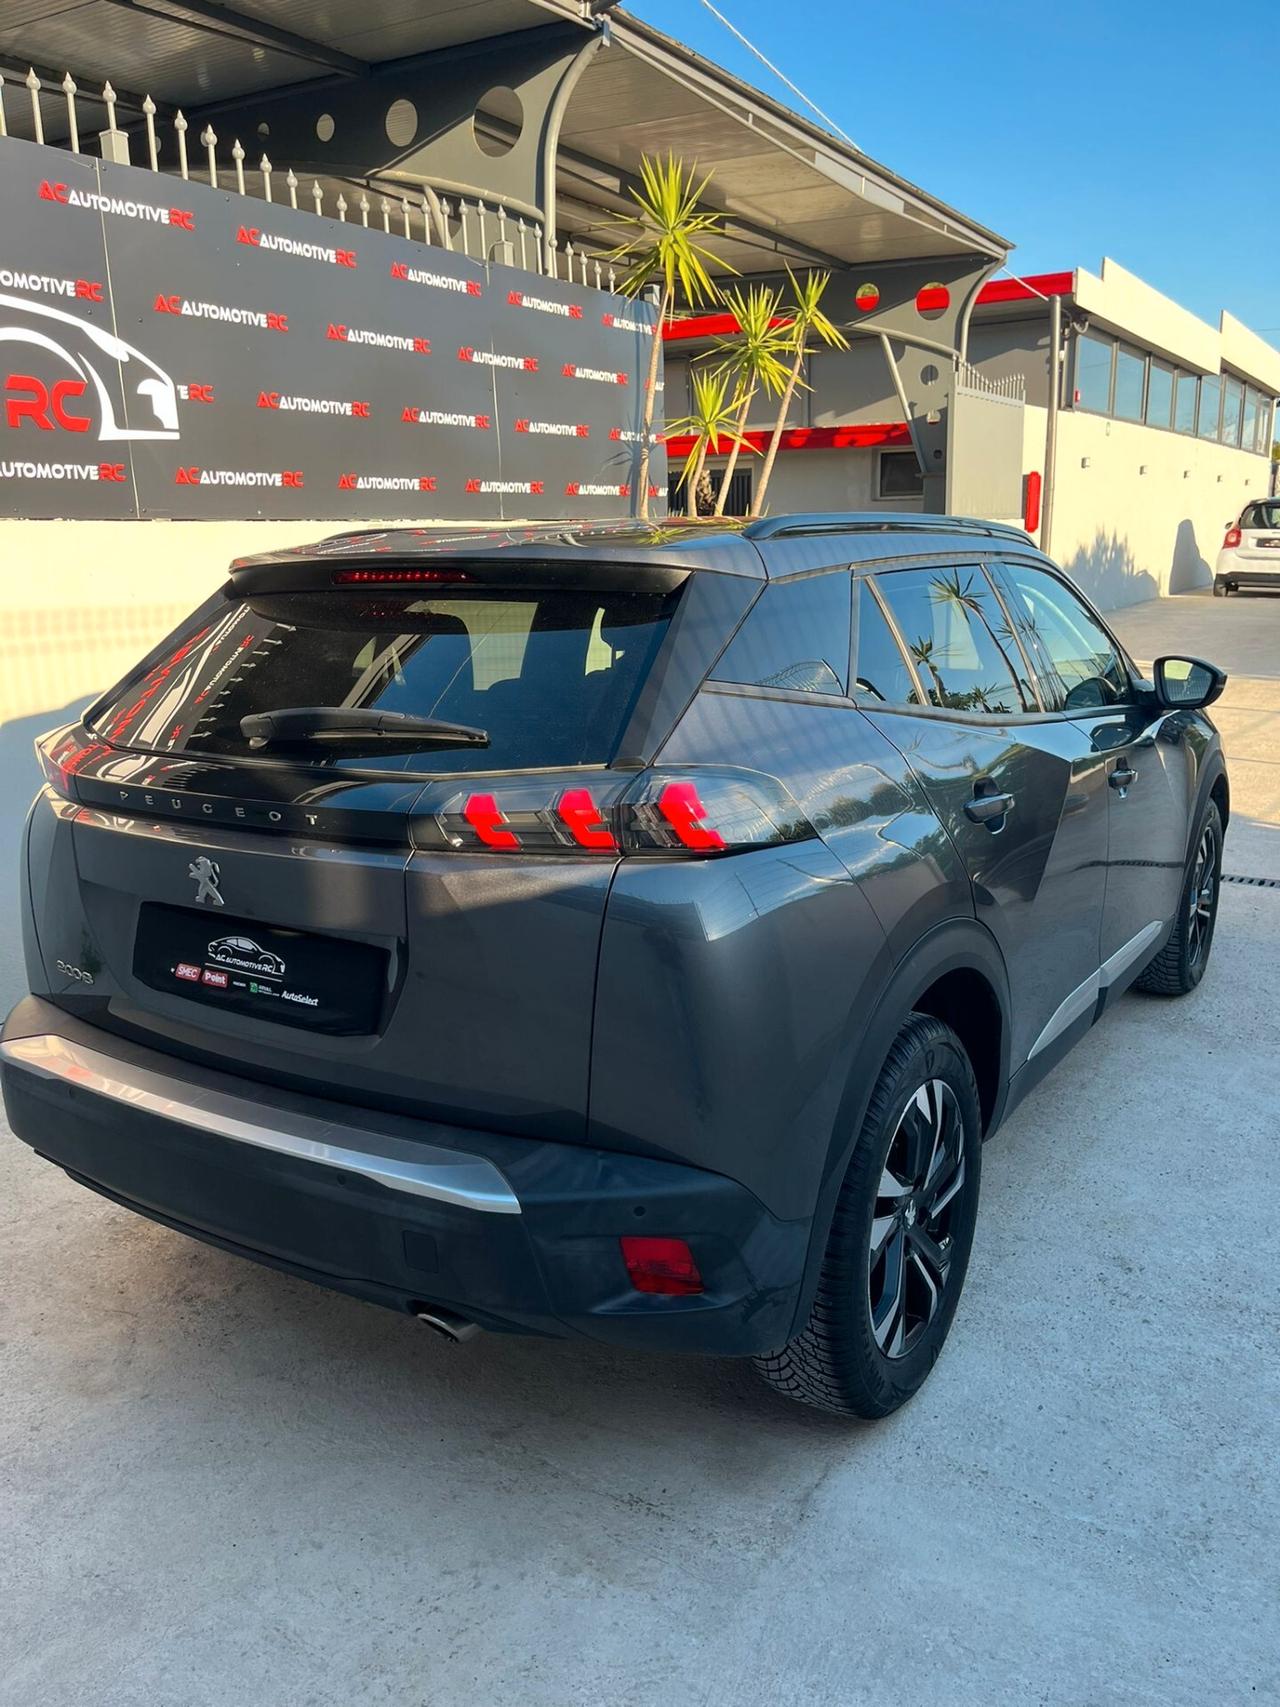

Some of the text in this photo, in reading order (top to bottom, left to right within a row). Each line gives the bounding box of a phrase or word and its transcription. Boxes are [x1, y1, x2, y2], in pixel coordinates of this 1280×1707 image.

[4, 374, 92, 433] RC
[177, 383, 215, 404] ERC
[0, 461, 126, 483] UTOMOTIVERC
[119, 791, 318, 825] PEUGEOT
[205, 972, 226, 985] Point
[281, 990, 319, 1007] AutoSelect
